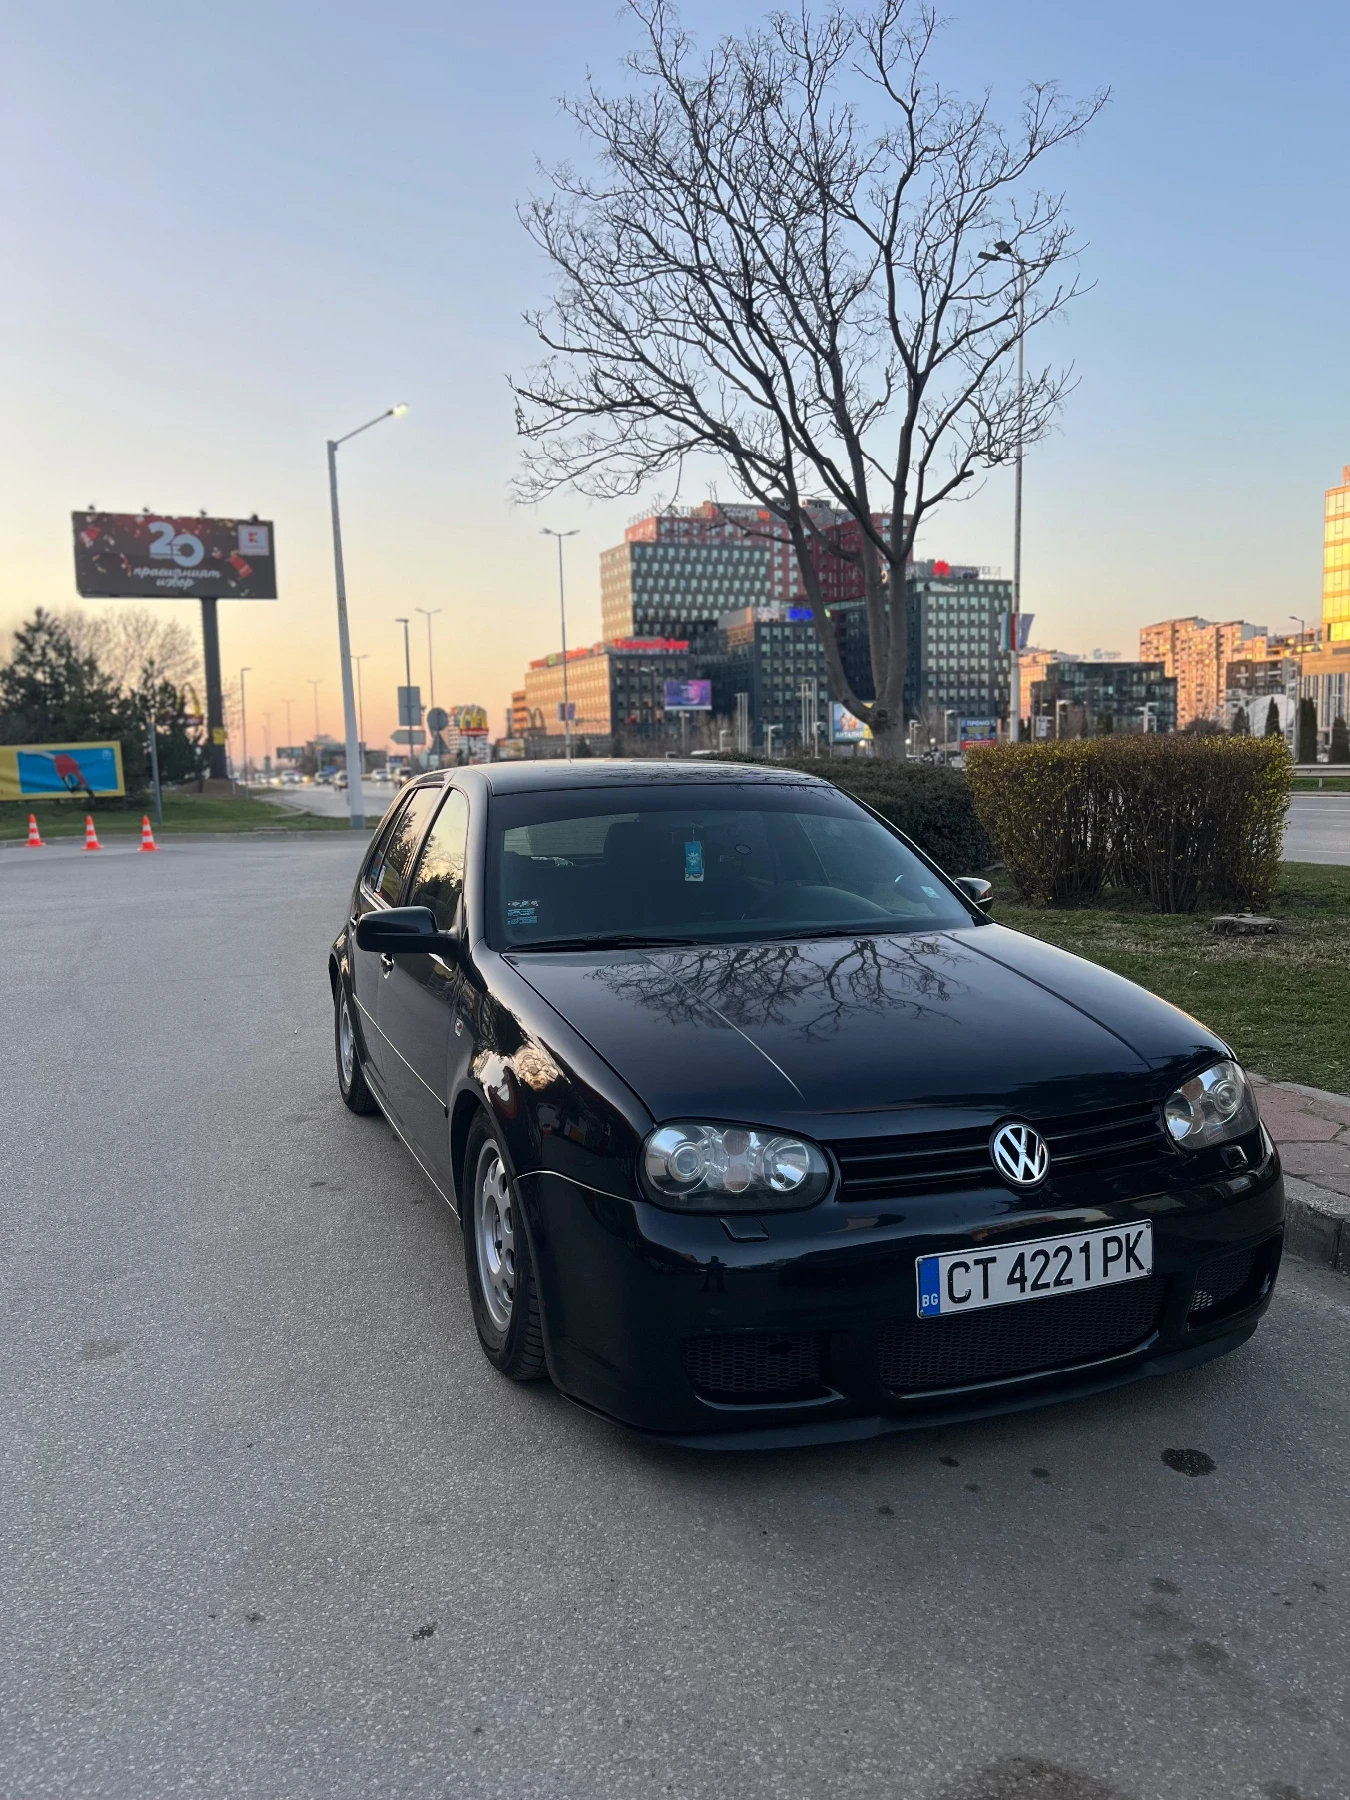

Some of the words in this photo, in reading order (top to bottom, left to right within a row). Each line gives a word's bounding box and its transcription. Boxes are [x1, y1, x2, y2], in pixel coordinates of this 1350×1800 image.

[148, 521, 204, 567] 20
[947, 1256, 997, 1304] CT
[1006, 1240, 1091, 1294] 4221
[1102, 1229, 1146, 1278] PK
[921, 1292, 939, 1307] BG
